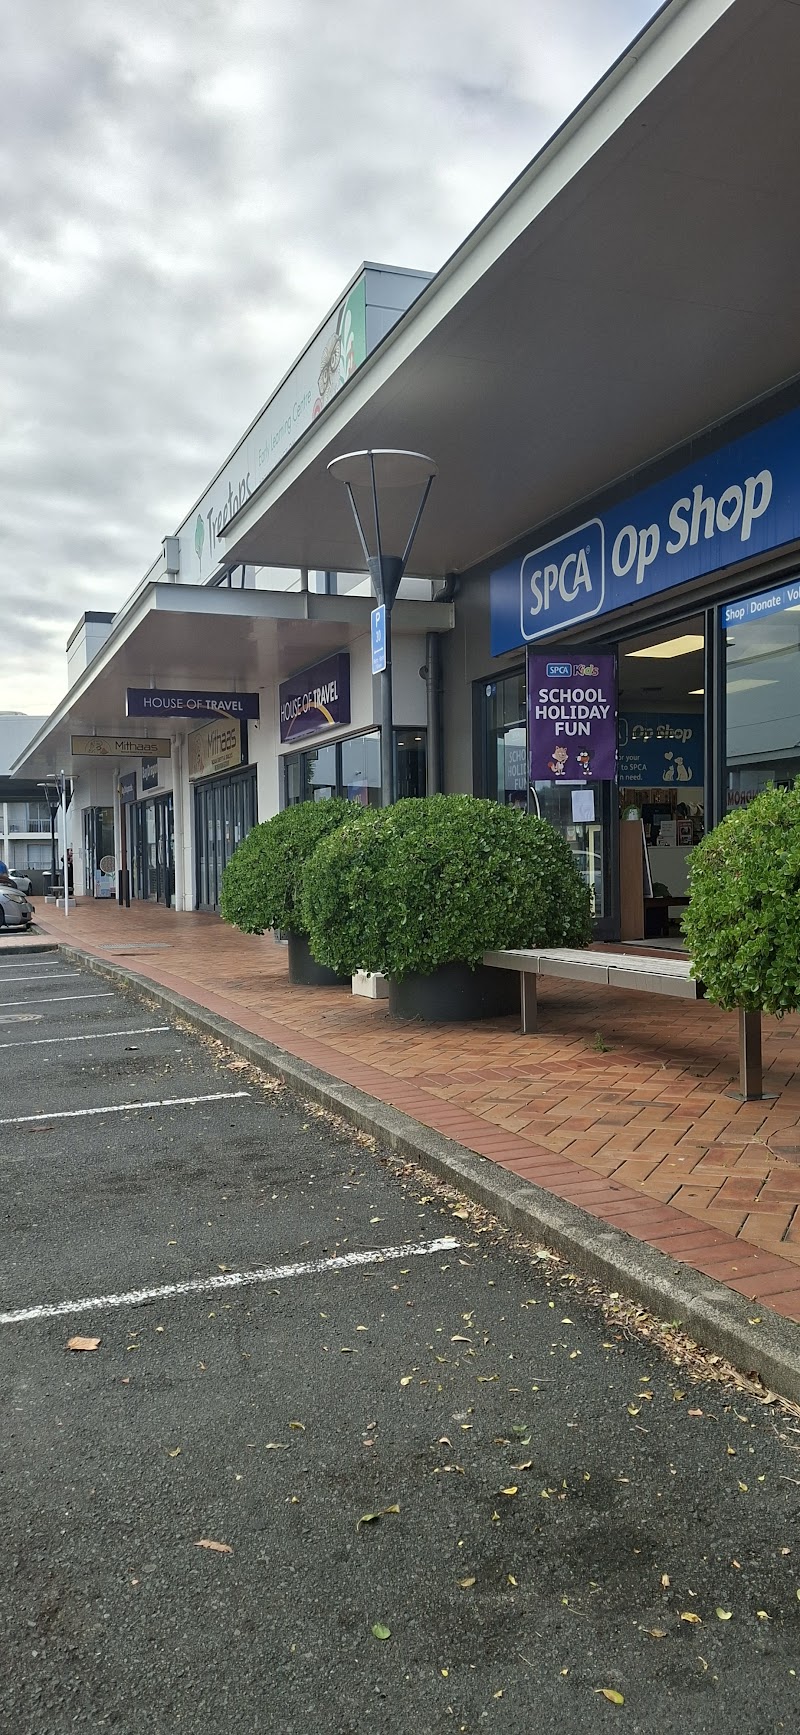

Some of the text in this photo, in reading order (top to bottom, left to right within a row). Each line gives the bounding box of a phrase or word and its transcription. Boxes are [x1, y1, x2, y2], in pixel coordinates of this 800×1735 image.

[270, 416, 292, 451] Learning
[293, 391, 312, 422] Centre
[206, 472, 253, 557] Treetops
[530, 469, 773, 616] SPCA Op Shop
[725, 607, 745, 621] Shop
[750, 596, 781, 613] Donate
[375, 611, 381, 628] P
[549, 664, 600, 677] SPCA Kids
[280, 680, 338, 723] HOUSE OF TRAVEL
[538, 688, 607, 703] SCHOOL
[143, 697, 243, 712] HOUSE OF TRAVEL
[535, 705, 610, 720] HOLIDAY
[555, 722, 591, 736] FUN
[632, 725, 654, 743] Op
[656, 724, 693, 743] Shop
[115, 741, 158, 752] Mithaas
[207, 728, 236, 758] Mithaas
[509, 749, 526, 763] SCHO
[626, 755, 640, 764] your
[630, 763, 647, 771] SPCA
[625, 773, 642, 781] need.
